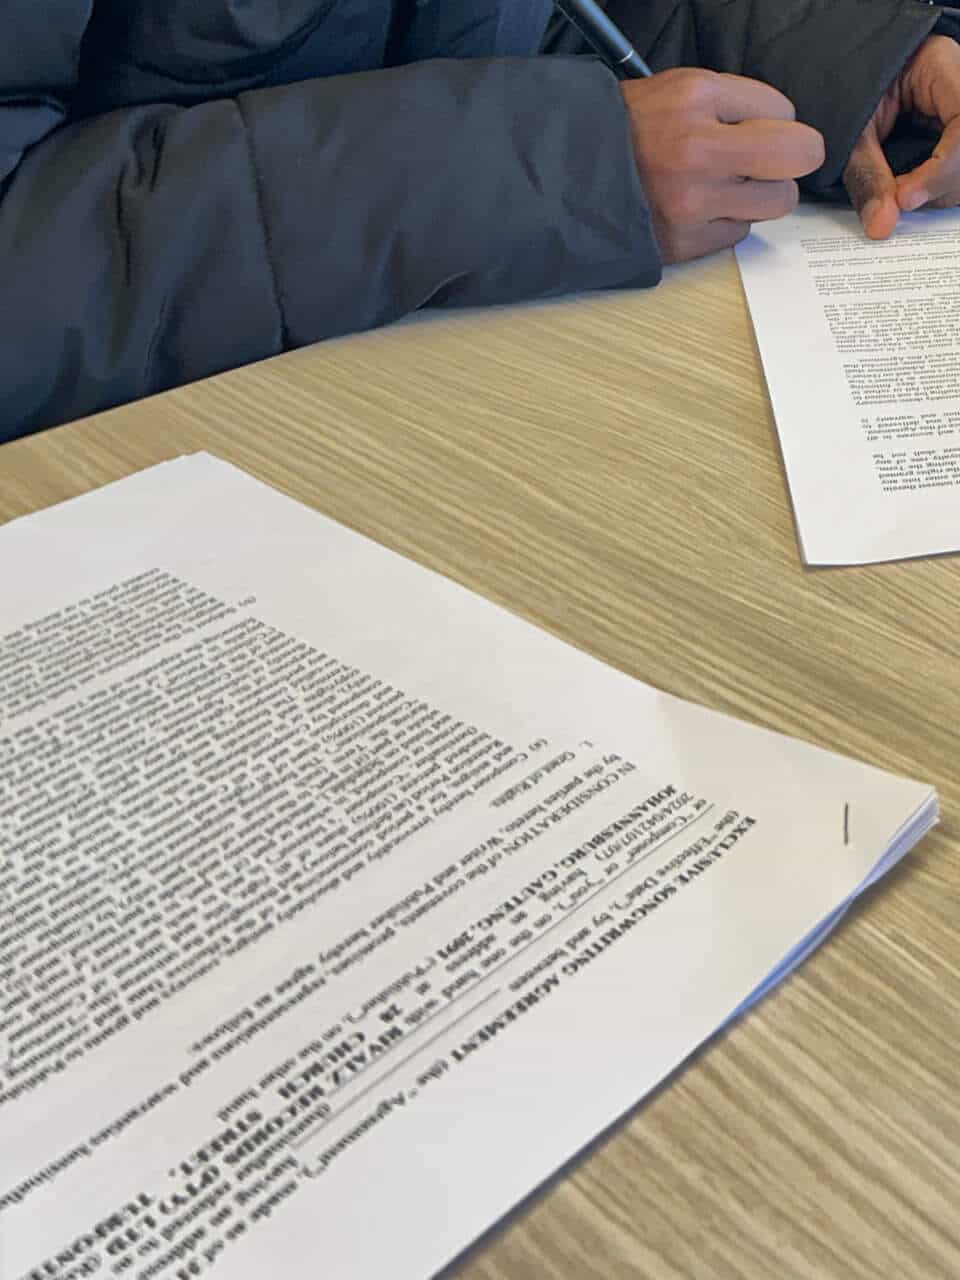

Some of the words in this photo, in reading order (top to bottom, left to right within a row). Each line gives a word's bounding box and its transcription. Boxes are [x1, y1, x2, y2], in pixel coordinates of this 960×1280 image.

[543, 776, 584, 806] parties
[502, 773, 619, 855] CONSIDERATION
[553, 784, 677, 875] JOHANNESBURG,
[459, 837, 504, 867] Writer
[463, 864, 495, 880] the
[673, 816, 756, 886] EXCLUSIVE
[432, 865, 458, 886] and
[536, 868, 588, 903] having
[370, 883, 435, 930] Publisher
[469, 870, 558, 931] GAUTENG,
[592, 912, 614, 928] by
[319, 928, 370, 964] hereby
[509, 929, 533, 947] the
[561, 883, 677, 976] SONGWRITING
[565, 927, 592, 951] and
[445, 933, 497, 973] address
[480, 948, 507, 969] one
[508, 947, 568, 992] between
[440, 969, 481, 1001] hand
[450, 973, 560, 1062] AGREEMENT
[277, 1032, 365, 1099] CHURCH
[168, 1109, 263, 1178] STREET,
[222, 1084, 333, 1168] RECORDS
[158, 1165, 220, 1216] (PTY)
[105, 1214, 157, 1256] LTD
